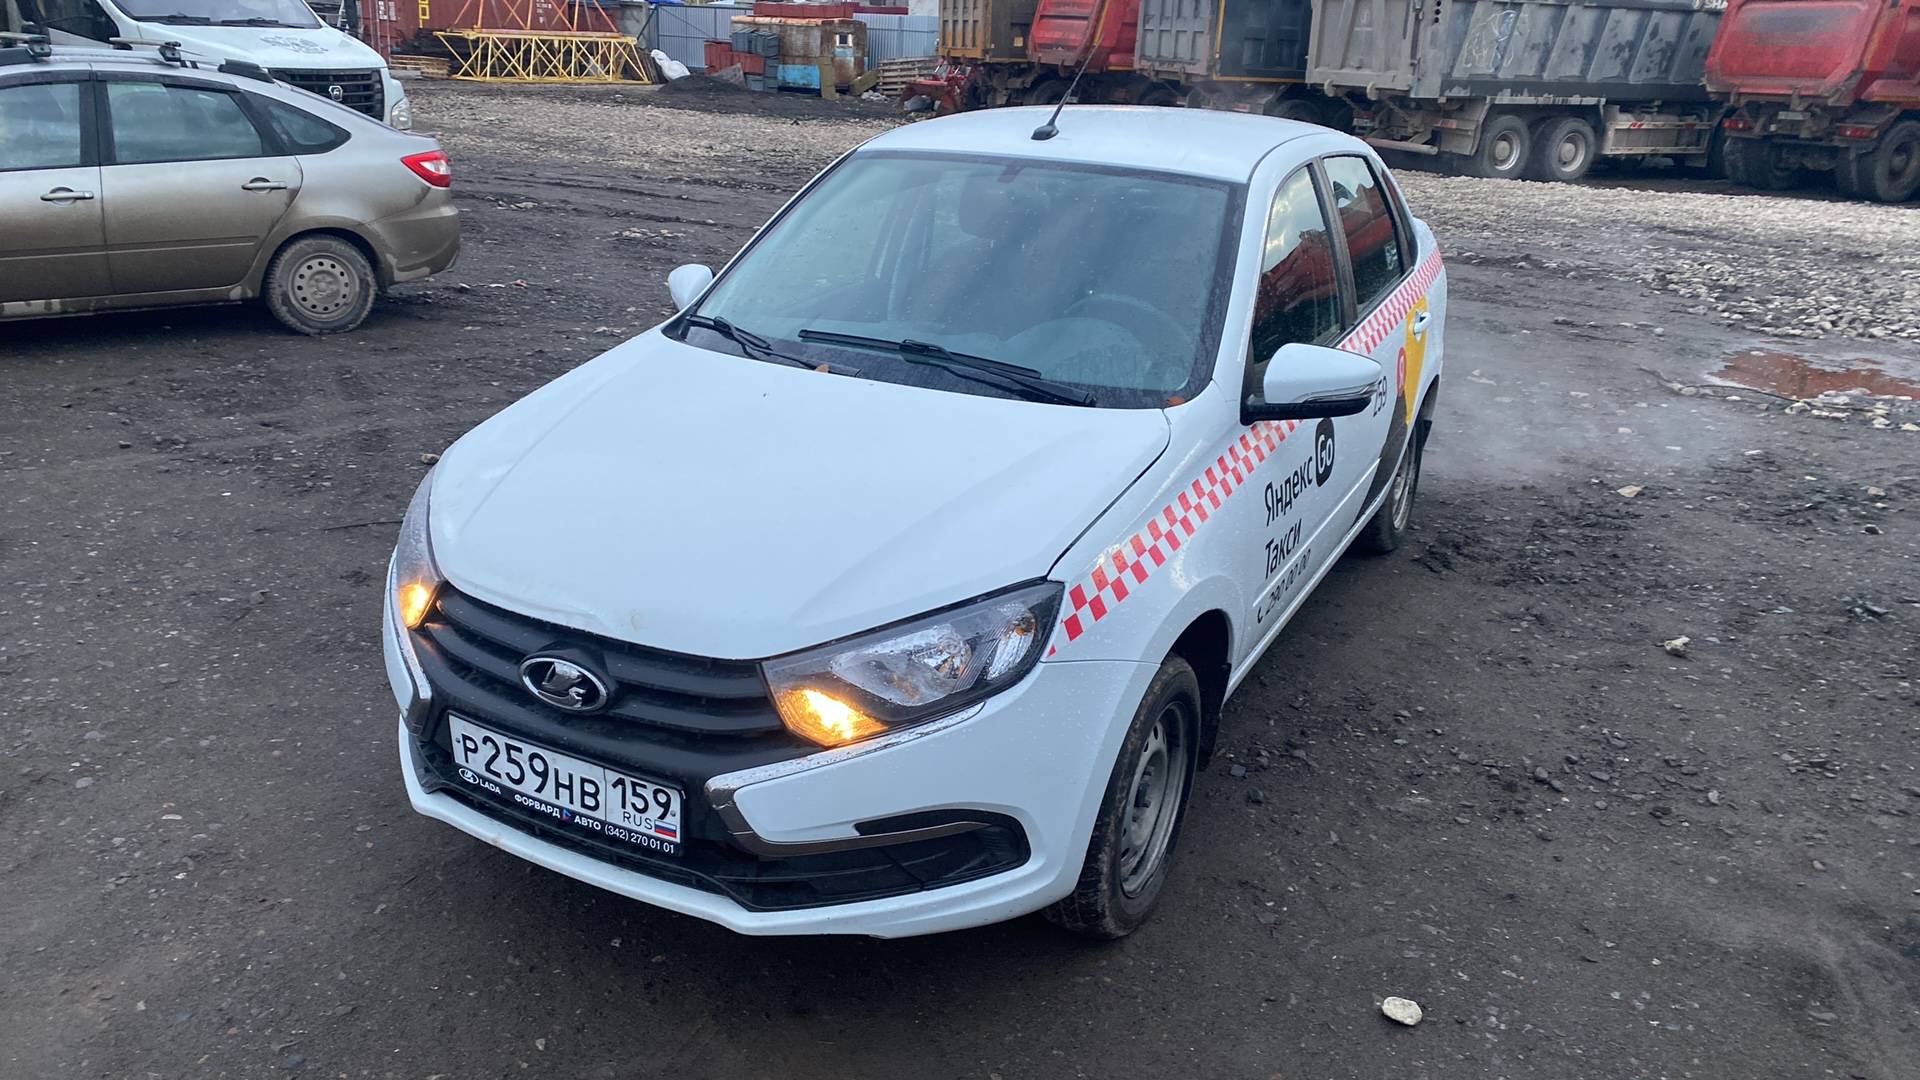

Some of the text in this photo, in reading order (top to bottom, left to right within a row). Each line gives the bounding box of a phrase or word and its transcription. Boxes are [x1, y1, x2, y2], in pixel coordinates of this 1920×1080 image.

[1265, 434, 1333, 526] Яндекс Go
[1265, 518, 1302, 579] Такси
[480, 779, 674, 854] LADA ФОРВАРД АВТО (342) 270 01 01
[611, 777, 672, 821] 159
[623, 811, 653, 830] RUS
